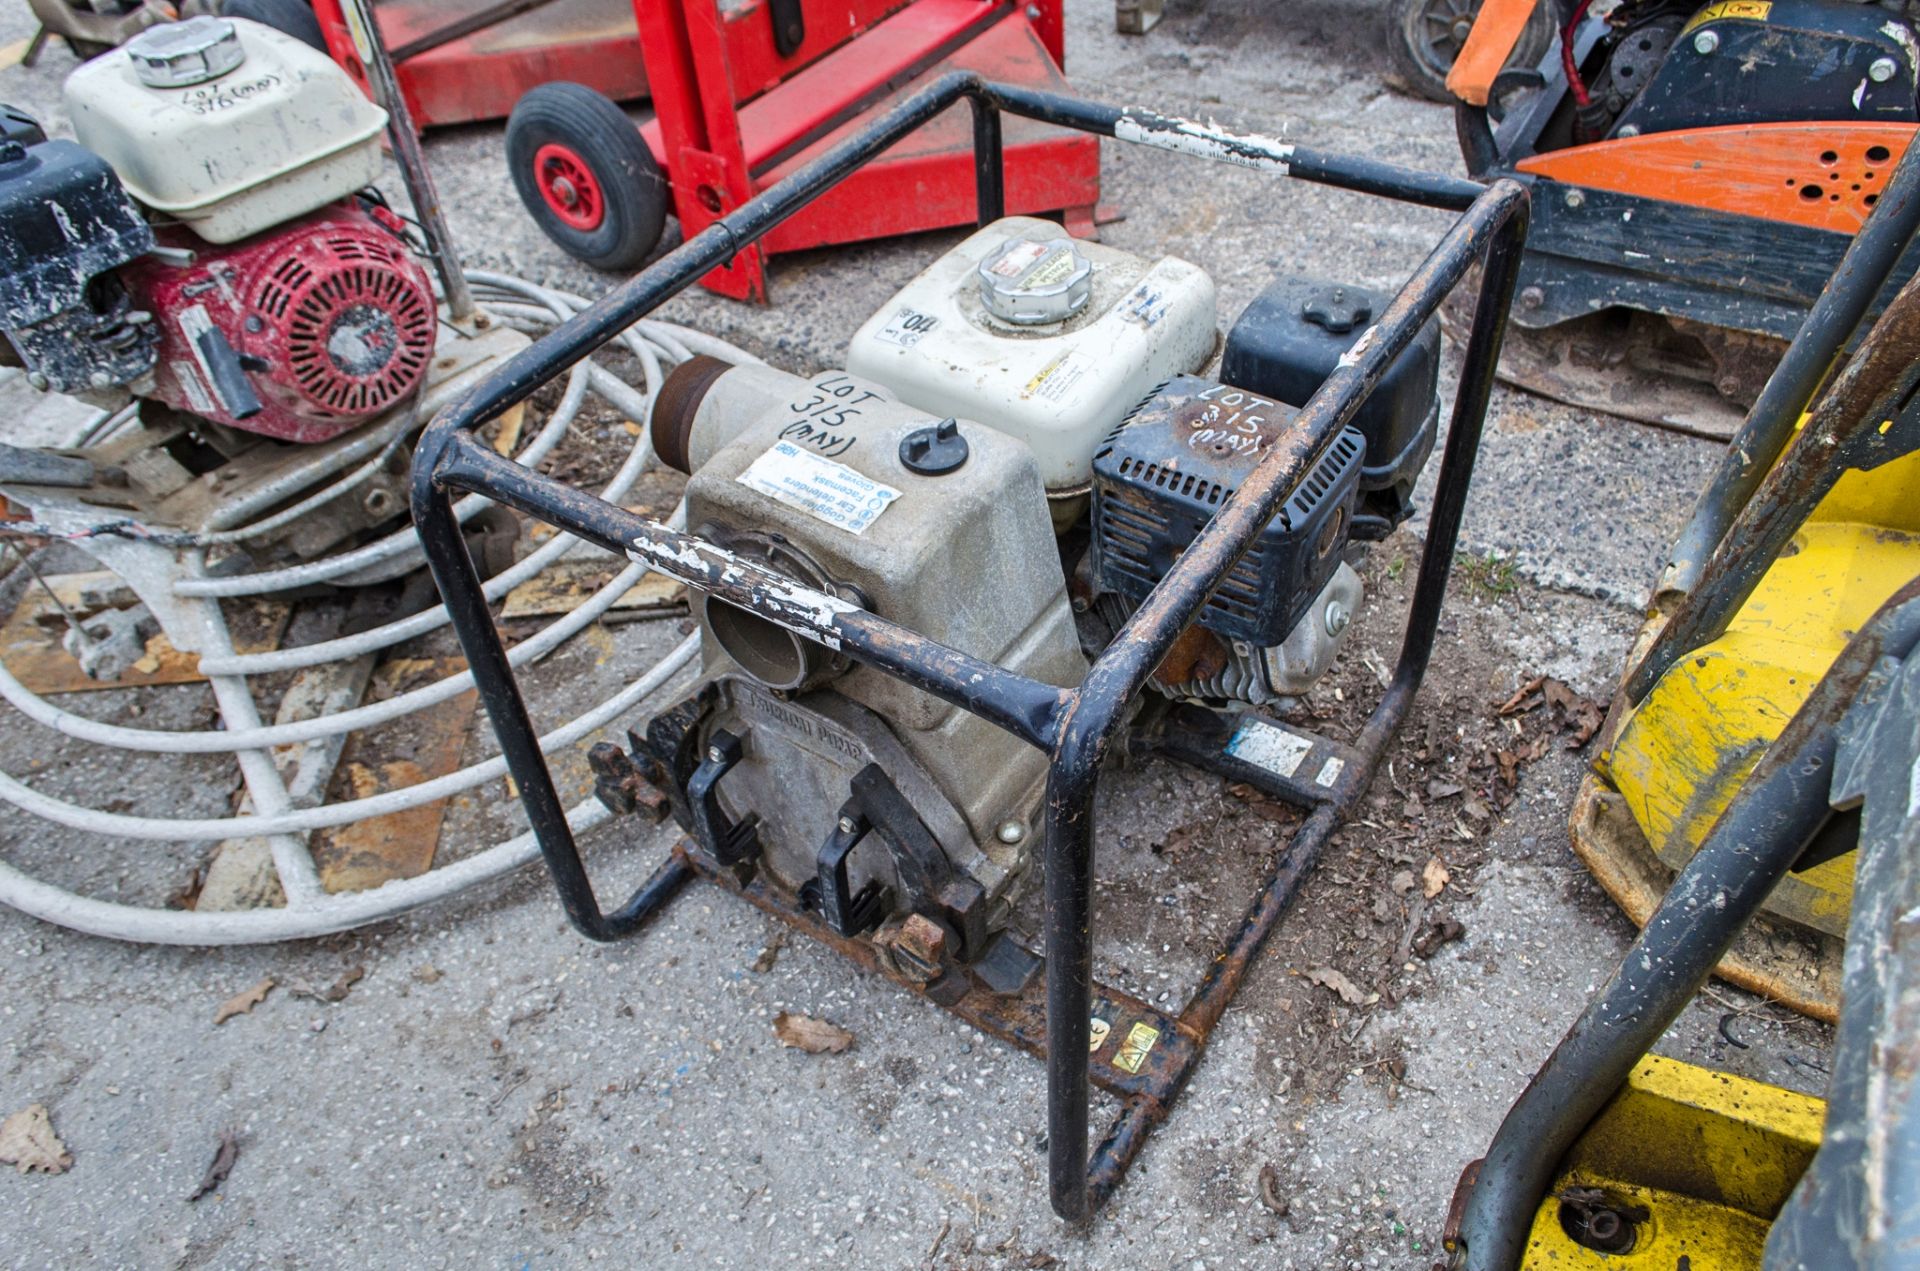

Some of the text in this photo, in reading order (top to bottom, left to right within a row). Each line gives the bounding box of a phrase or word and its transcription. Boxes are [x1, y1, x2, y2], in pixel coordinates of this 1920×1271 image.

[815, 376, 886, 405] LOT
[1198, 385, 1274, 411] LOT
[791, 395, 862, 427] 315
[1202, 404, 1265, 433] 315
[783, 476, 836, 504] defenders
[813, 475, 865, 502] Facemask
[838, 472, 875, 492] Gloves
[800, 498, 846, 522] Goggles
[838, 500, 856, 513] Ear
[817, 725, 862, 760] PUMP
